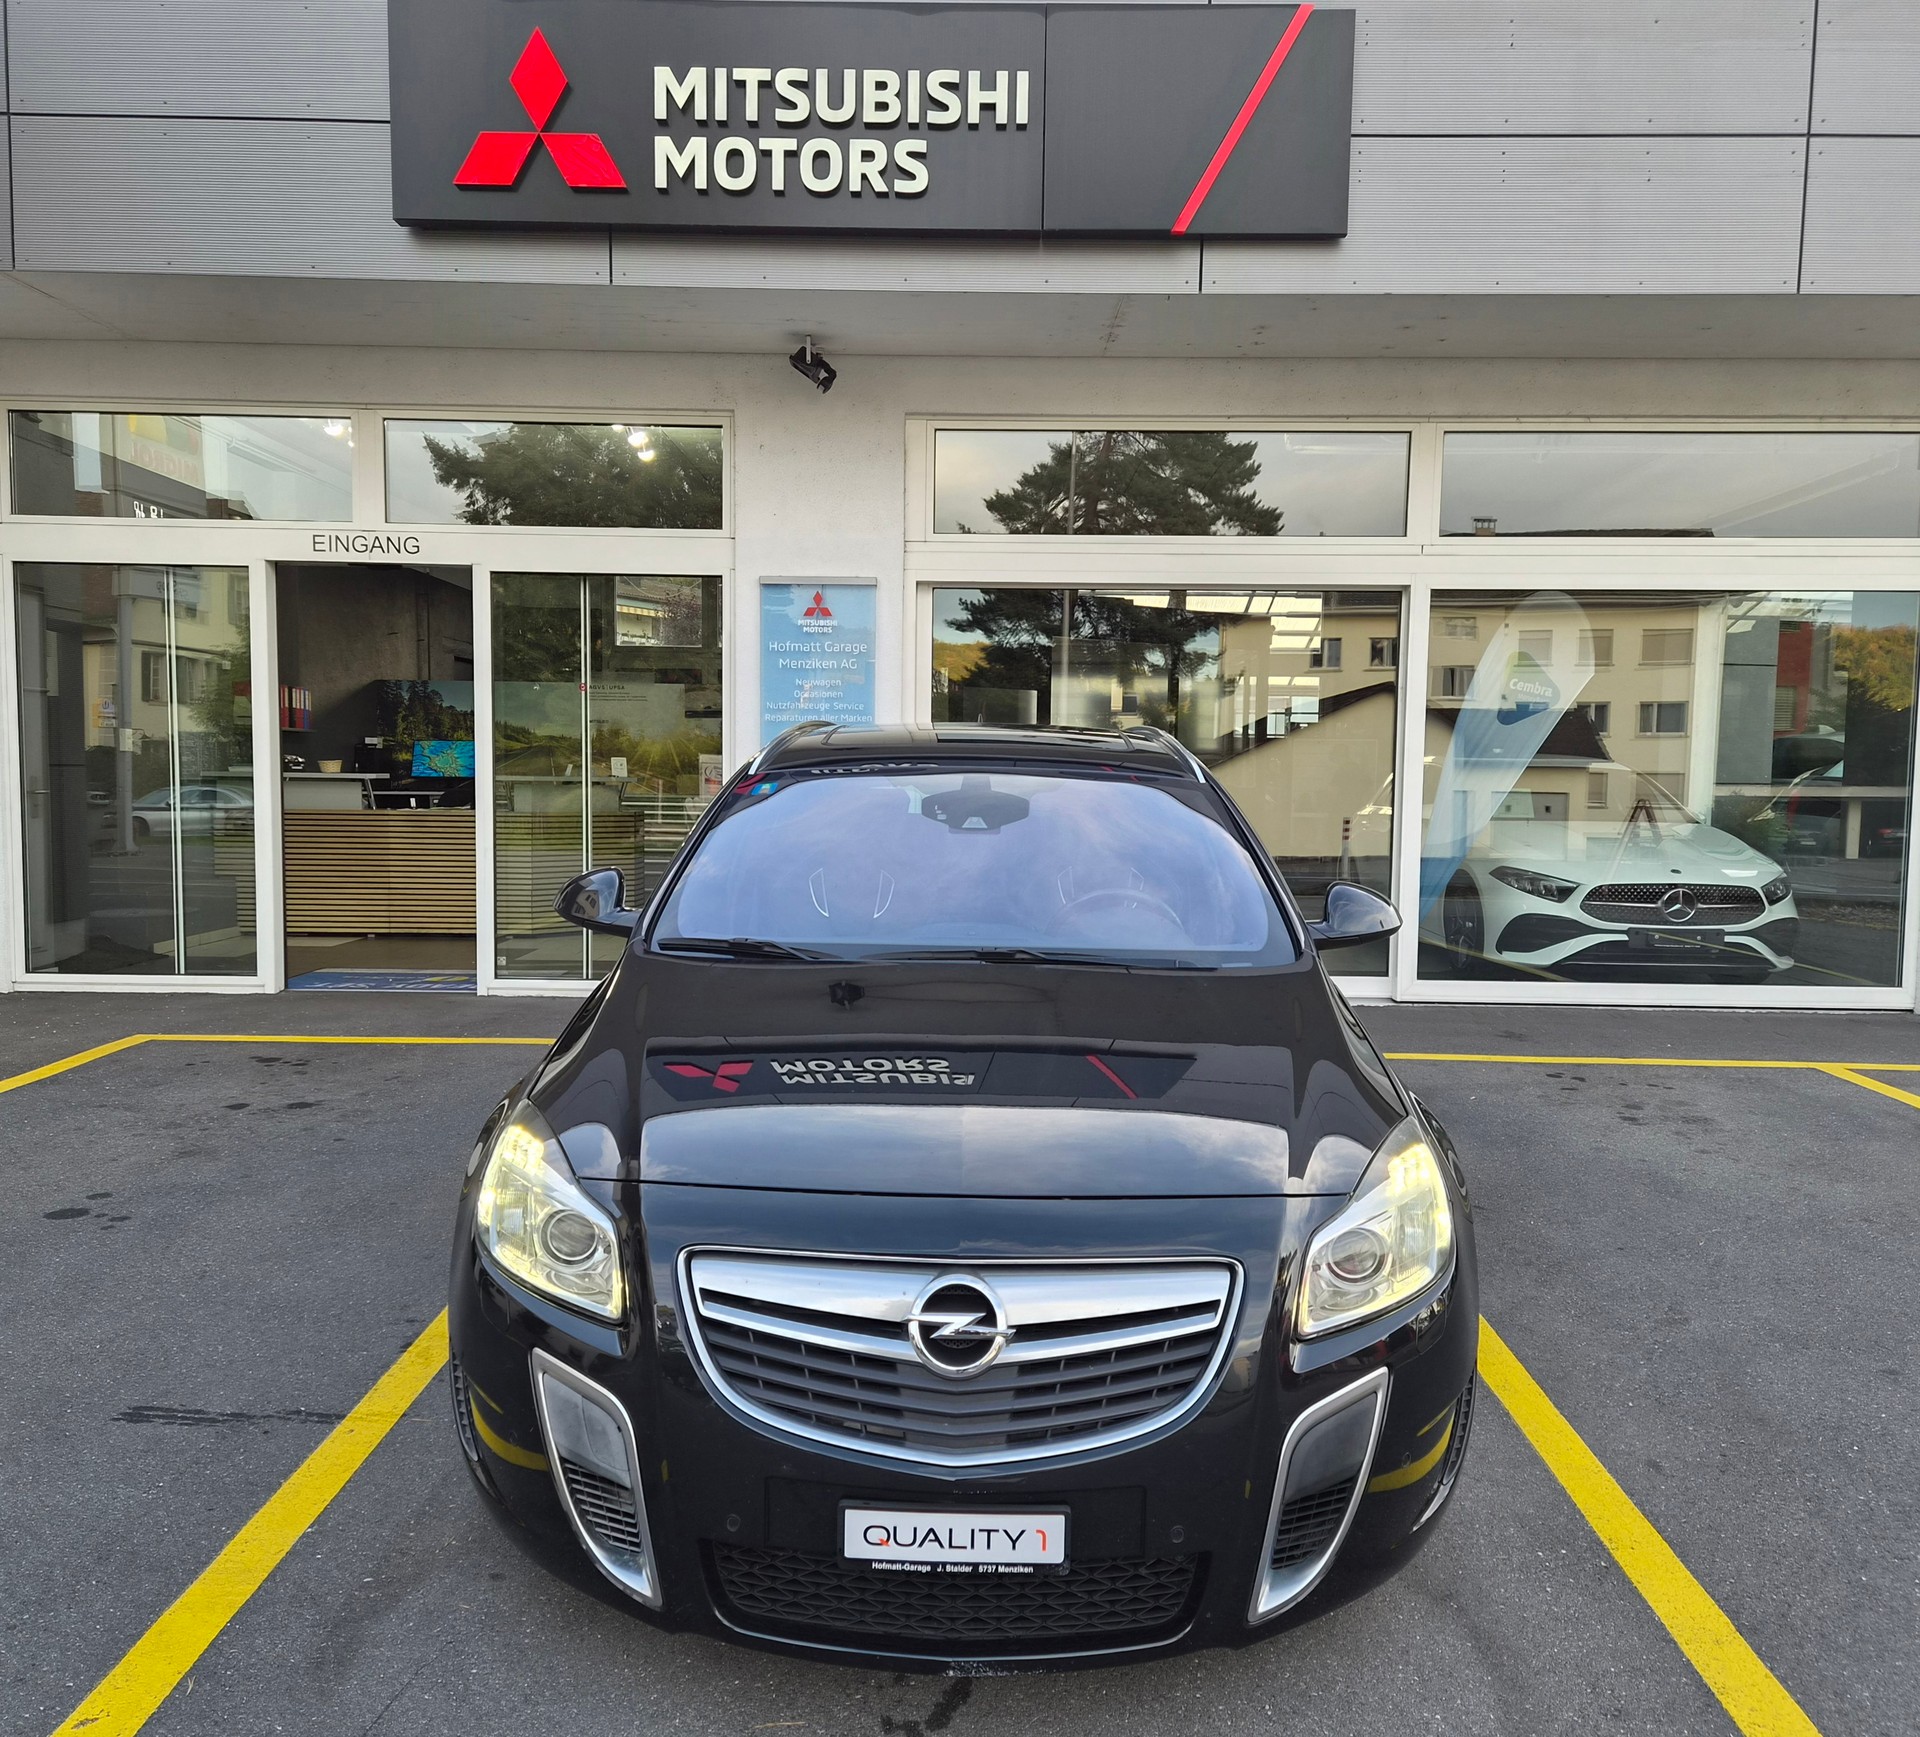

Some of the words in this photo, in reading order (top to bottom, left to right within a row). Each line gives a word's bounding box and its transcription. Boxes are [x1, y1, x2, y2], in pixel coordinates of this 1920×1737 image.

[653, 65, 1030, 125] MITSUBISHI
[653, 135, 930, 194] MOTORS
[312, 534, 421, 555] EINGANG
[797, 619, 838, 627] MITSUBISHI
[802, 626, 833, 634] MOTORS
[768, 641, 821, 652] Hofmatt
[824, 641, 868, 655] Garage
[779, 658, 837, 669] Menziken
[840, 658, 858, 669] AG
[795, 678, 842, 688] Neuwagen
[1509, 678, 1553, 698] Cembra
[793, 690, 844, 699] Occasionen
[766, 702, 830, 711] Nutzfahrzeuge
[833, 702, 865, 710] Service
[764, 713, 818, 722] Reparaturen
[820, 713, 839, 722] aller
[840, 713, 873, 722] Marken
[862, 1524, 1027, 1552] QUALITY
[1035, 1529, 1047, 1552] 1
[871, 1560, 932, 1573] Hofmatt-Garage
[936, 1565, 944, 1573] J.
[945, 1565, 973, 1573] Stalder
[978, 1565, 997, 1573] 5737
[997, 1565, 1035, 1574] Menziken
